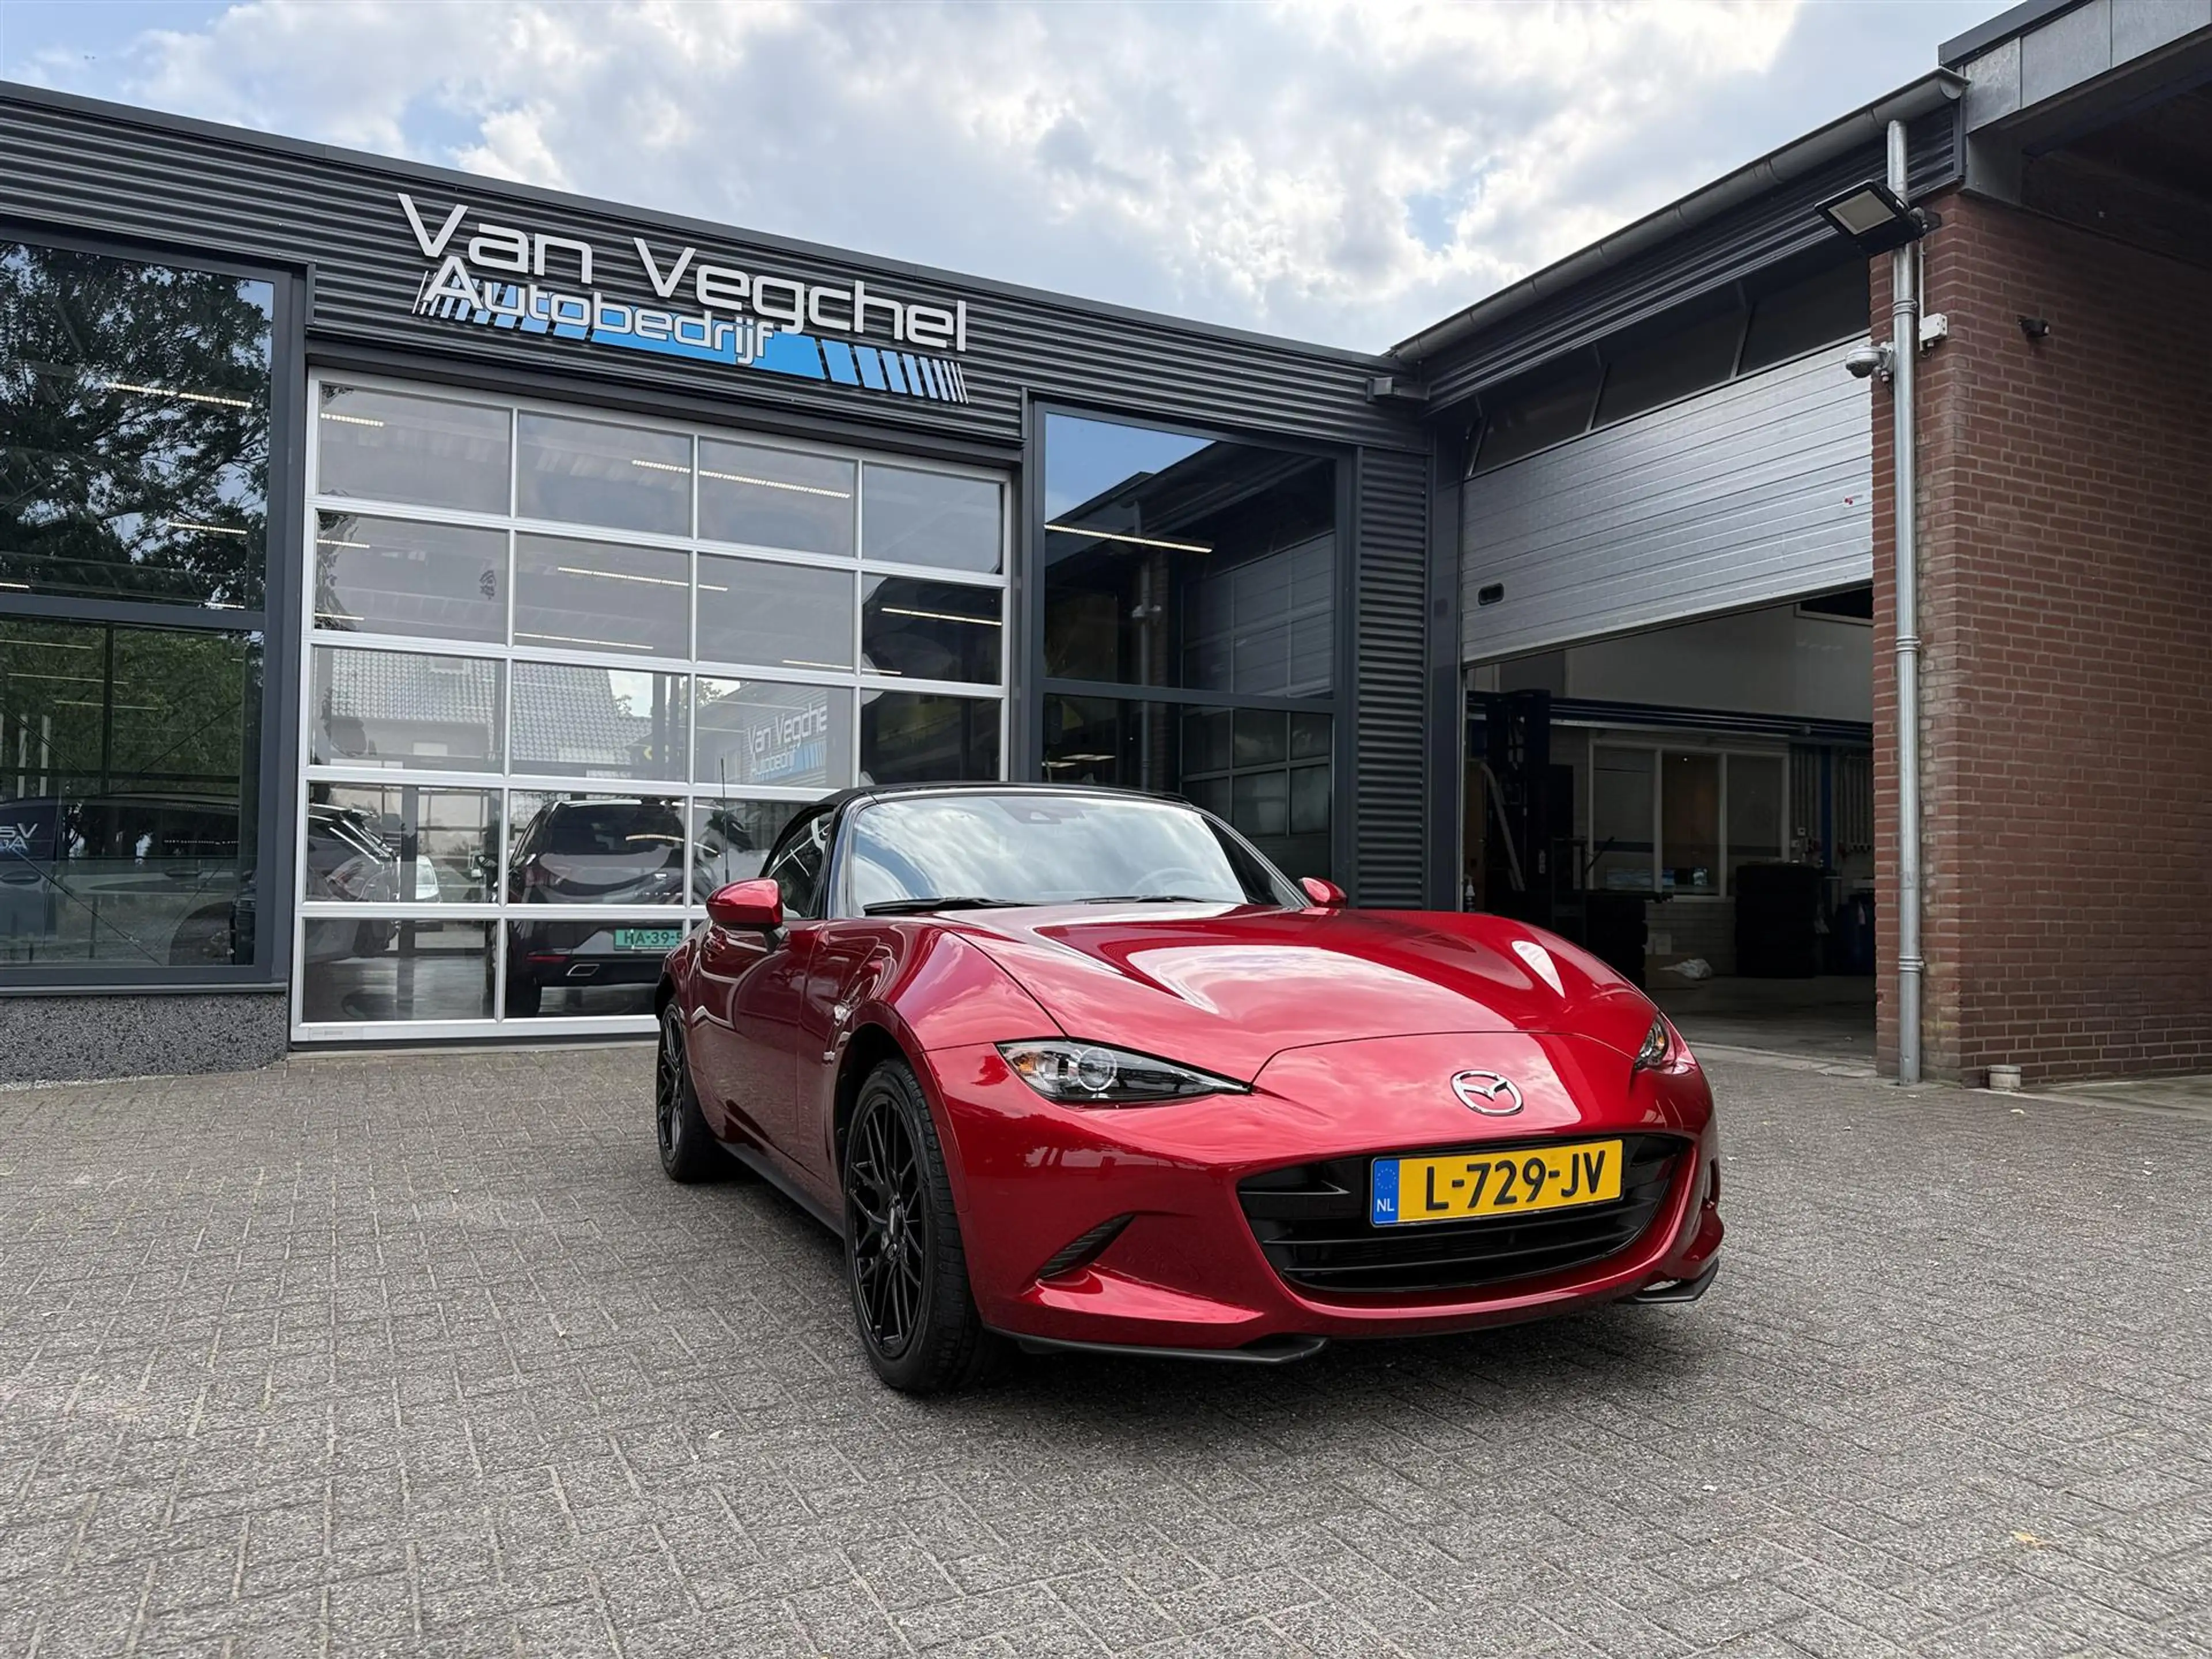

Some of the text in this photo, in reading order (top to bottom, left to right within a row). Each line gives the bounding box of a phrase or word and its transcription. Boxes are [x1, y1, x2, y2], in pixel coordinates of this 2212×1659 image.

[397, 192, 967, 352] Van Vegchel
[422, 255, 775, 364] Autobedrijf
[747, 702, 827, 755] Van Vegche
[624, 931, 683, 945] HA-39-5
[1376, 1198, 1395, 1213] NL
[1426, 1150, 1606, 1211] L-729-JV
